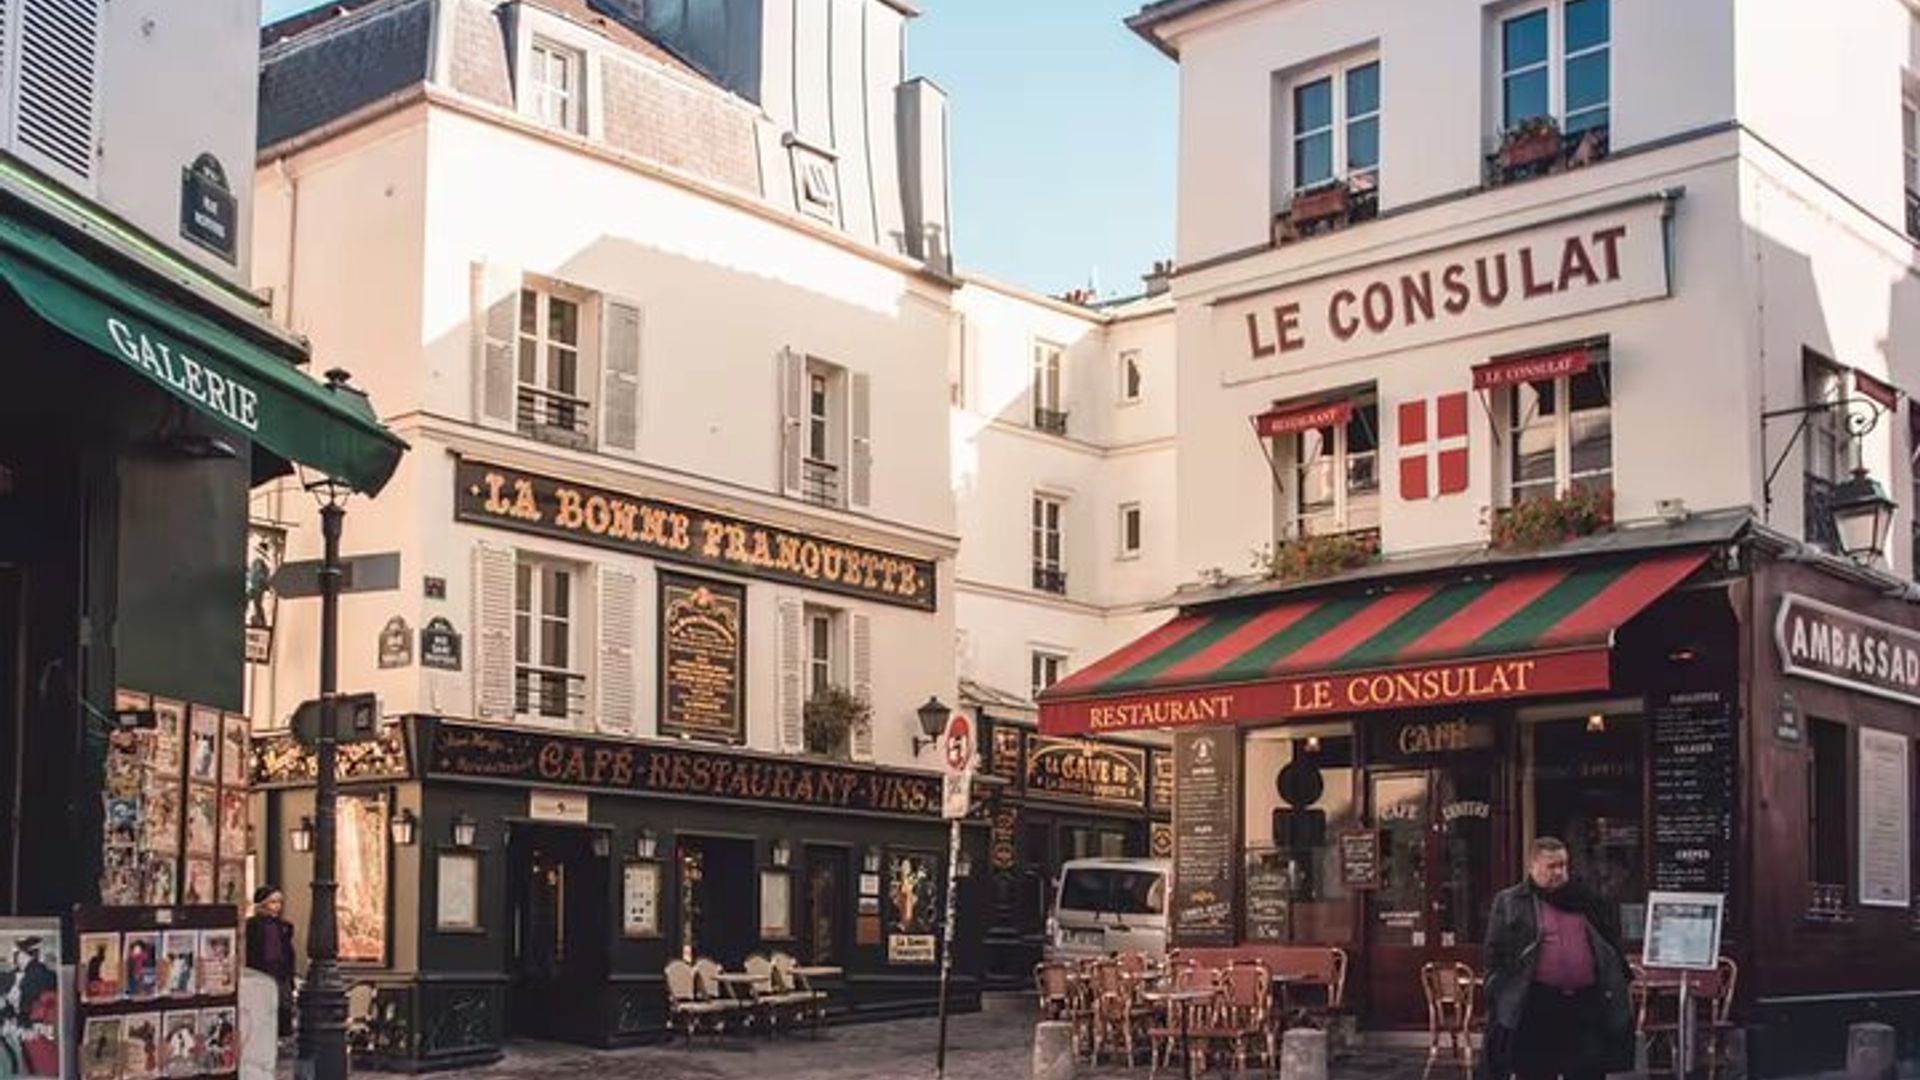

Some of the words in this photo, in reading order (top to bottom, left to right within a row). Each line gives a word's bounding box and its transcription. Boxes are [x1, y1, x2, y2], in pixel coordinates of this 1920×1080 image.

[1246, 303, 1305, 360] LE
[1328, 225, 1626, 342] CONSULAT
[107, 318, 259, 432] GALERIE
[485, 473, 542, 521] LA
[555, 488, 690, 550] BONNE
[702, 520, 916, 595] FRANQUETTE
[1792, 616, 1919, 686] AMBASSAD
[1090, 695, 1234, 728] RESTAURANT
[1293, 680, 1333, 711] LE
[1347, 661, 1534, 706] CONSULAT
[648, 752, 857, 805] RESTAURANT
[864, 776, 930, 812] VINS
[1062, 753, 1110, 784] CAVE
